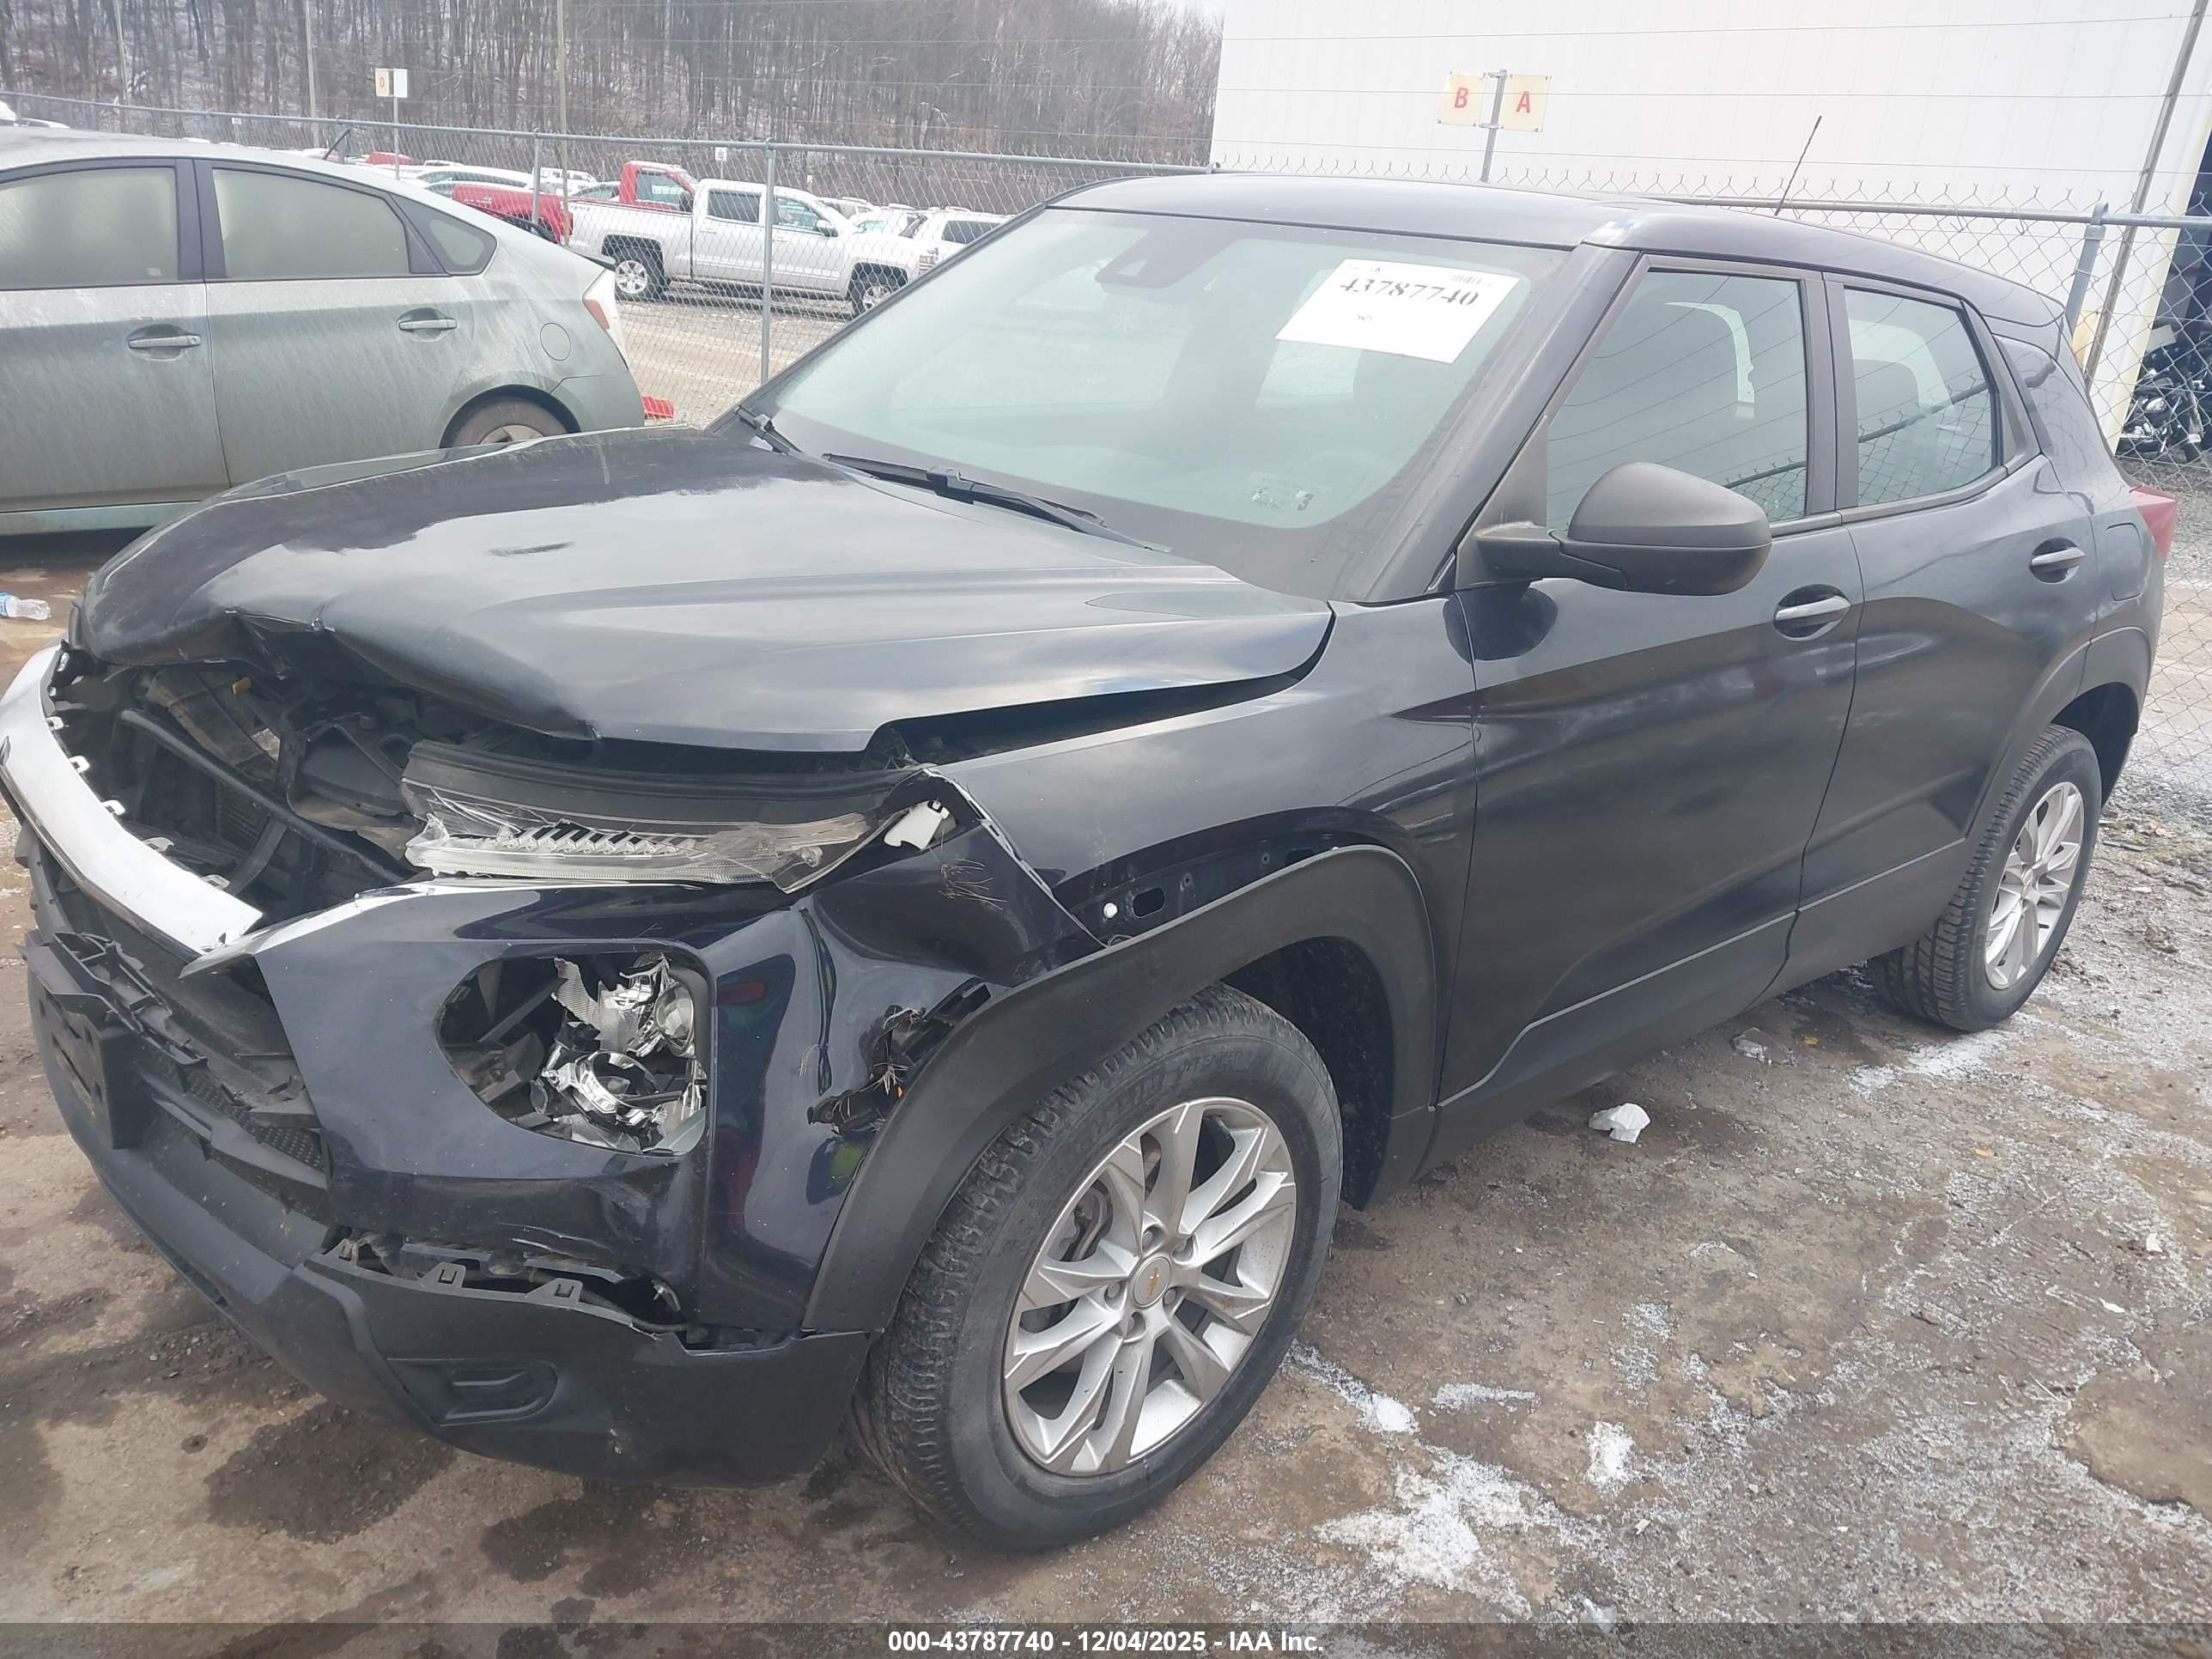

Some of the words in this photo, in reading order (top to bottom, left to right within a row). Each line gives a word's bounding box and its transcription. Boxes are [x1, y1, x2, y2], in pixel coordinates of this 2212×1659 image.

[1454, 87, 1469, 108] B
[1516, 90, 1531, 113] A
[1339, 276, 1480, 307] 43787740
